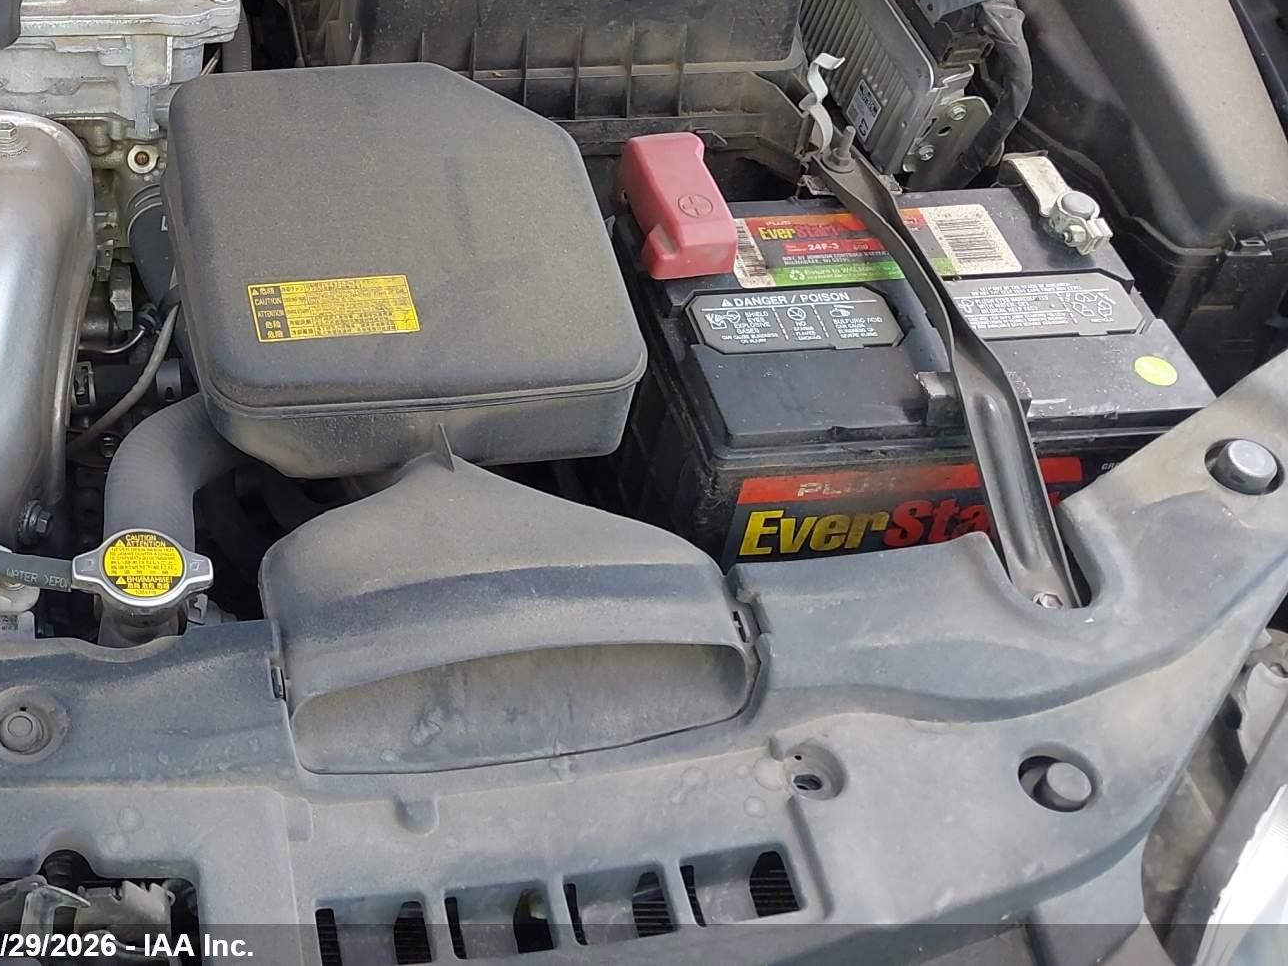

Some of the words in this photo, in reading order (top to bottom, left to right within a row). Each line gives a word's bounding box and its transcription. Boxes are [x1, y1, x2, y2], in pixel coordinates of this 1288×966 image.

[733, 295, 788, 307] DANGER
[790, 294, 797, 304] /
[799, 292, 851, 302] POISON
[797, 476, 897, 497] PL
[738, 499, 995, 556] EverSta
[6, 568, 38, 583] WATER
